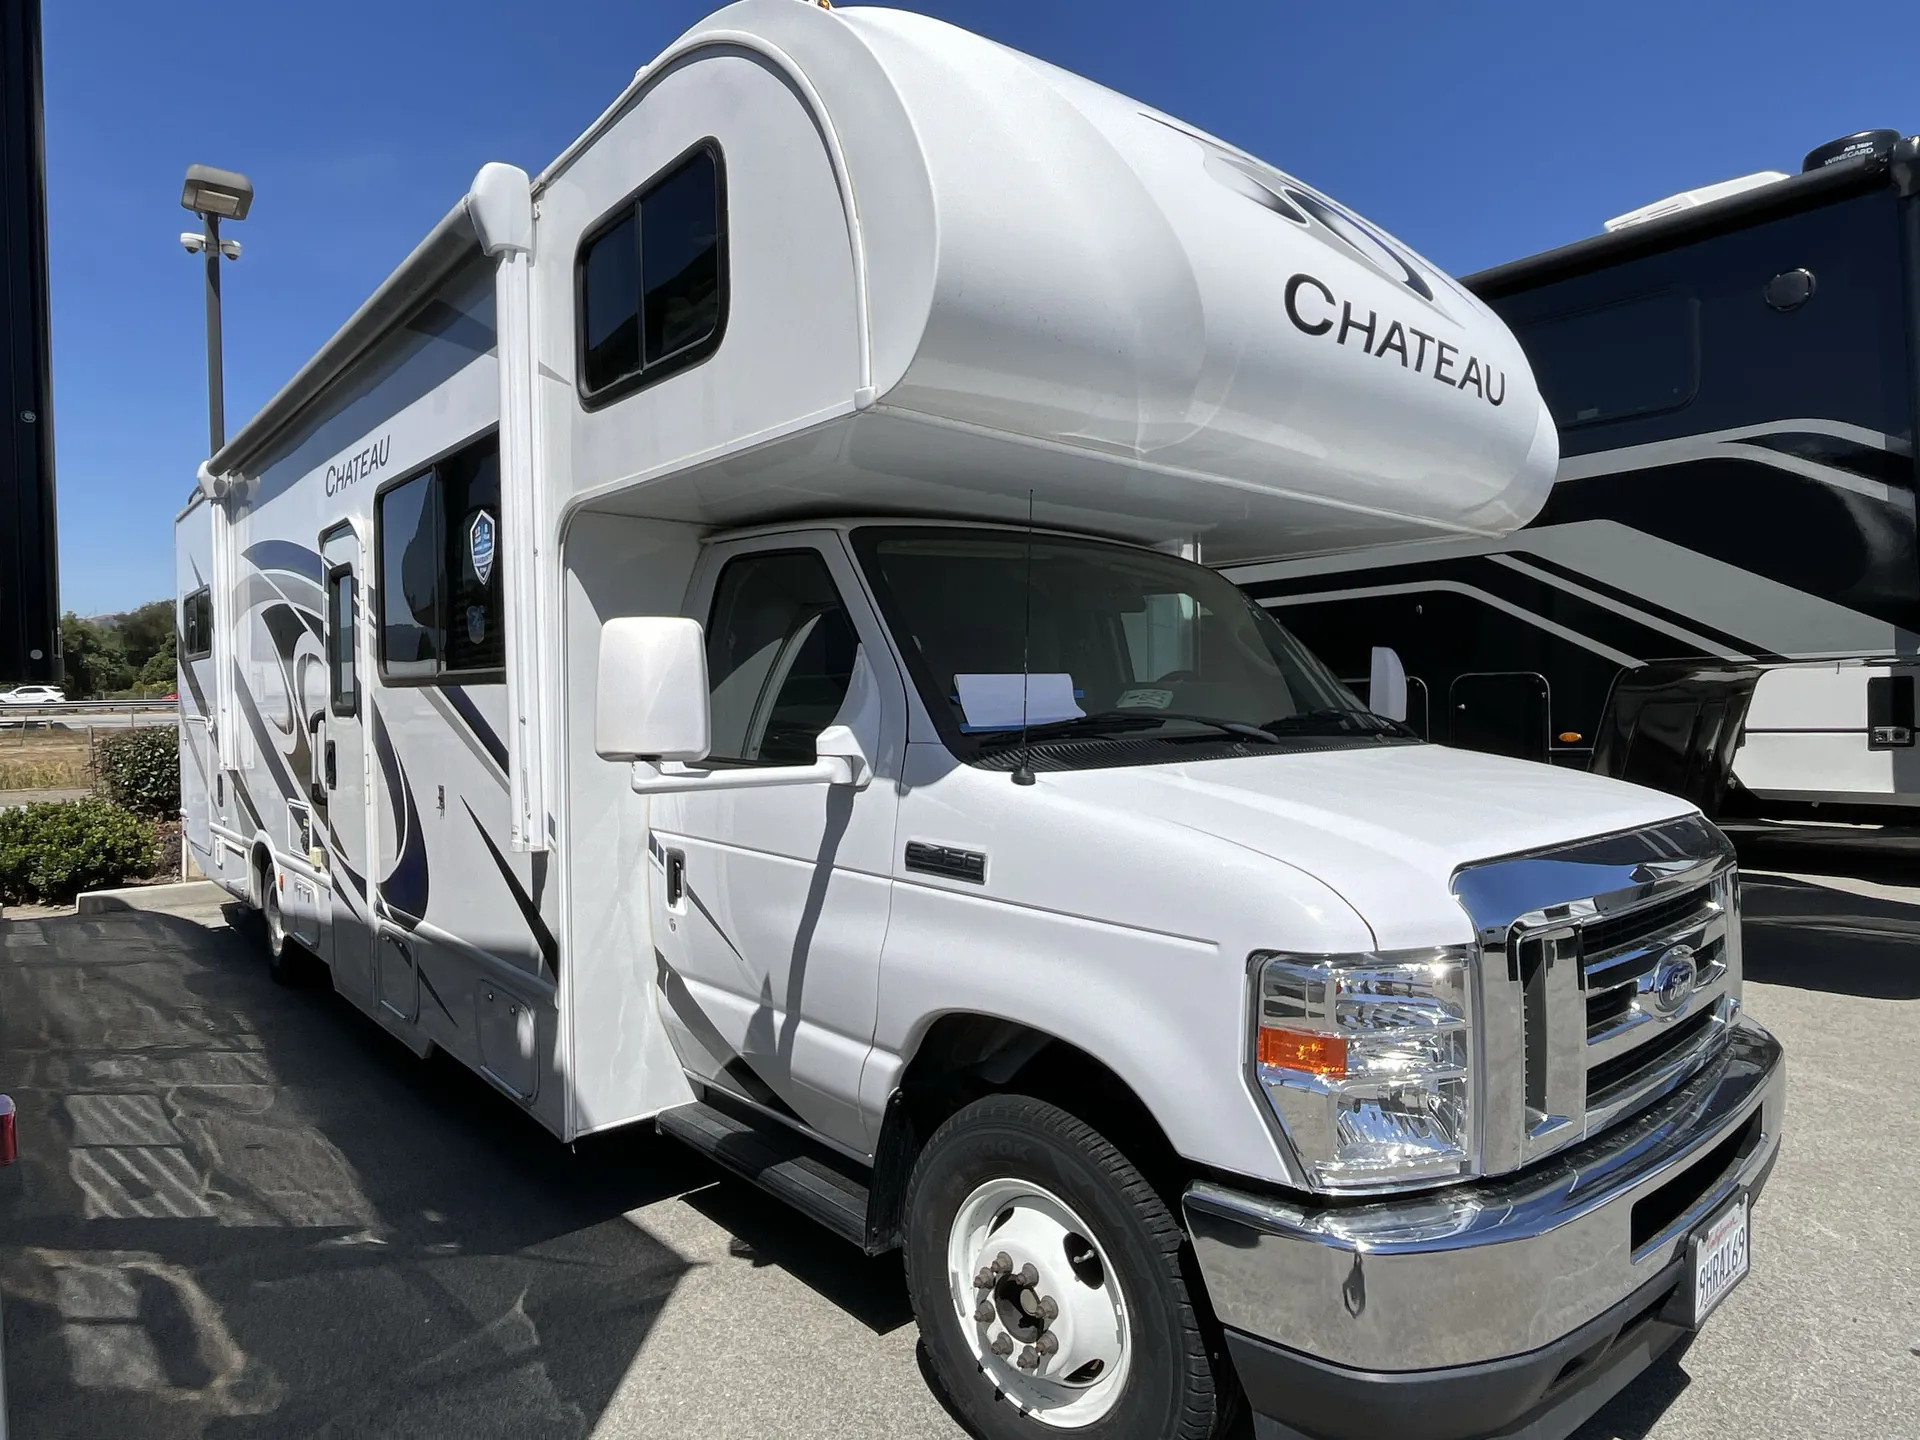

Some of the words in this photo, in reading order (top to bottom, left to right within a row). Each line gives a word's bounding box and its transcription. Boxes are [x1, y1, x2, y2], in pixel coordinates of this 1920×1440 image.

[1824, 147, 1874, 166] WINEGARD
[1283, 272, 1506, 407] CHATEAU
[325, 434, 391, 498] CHATEAU
[1698, 1226, 1745, 1309] 9HRA169
